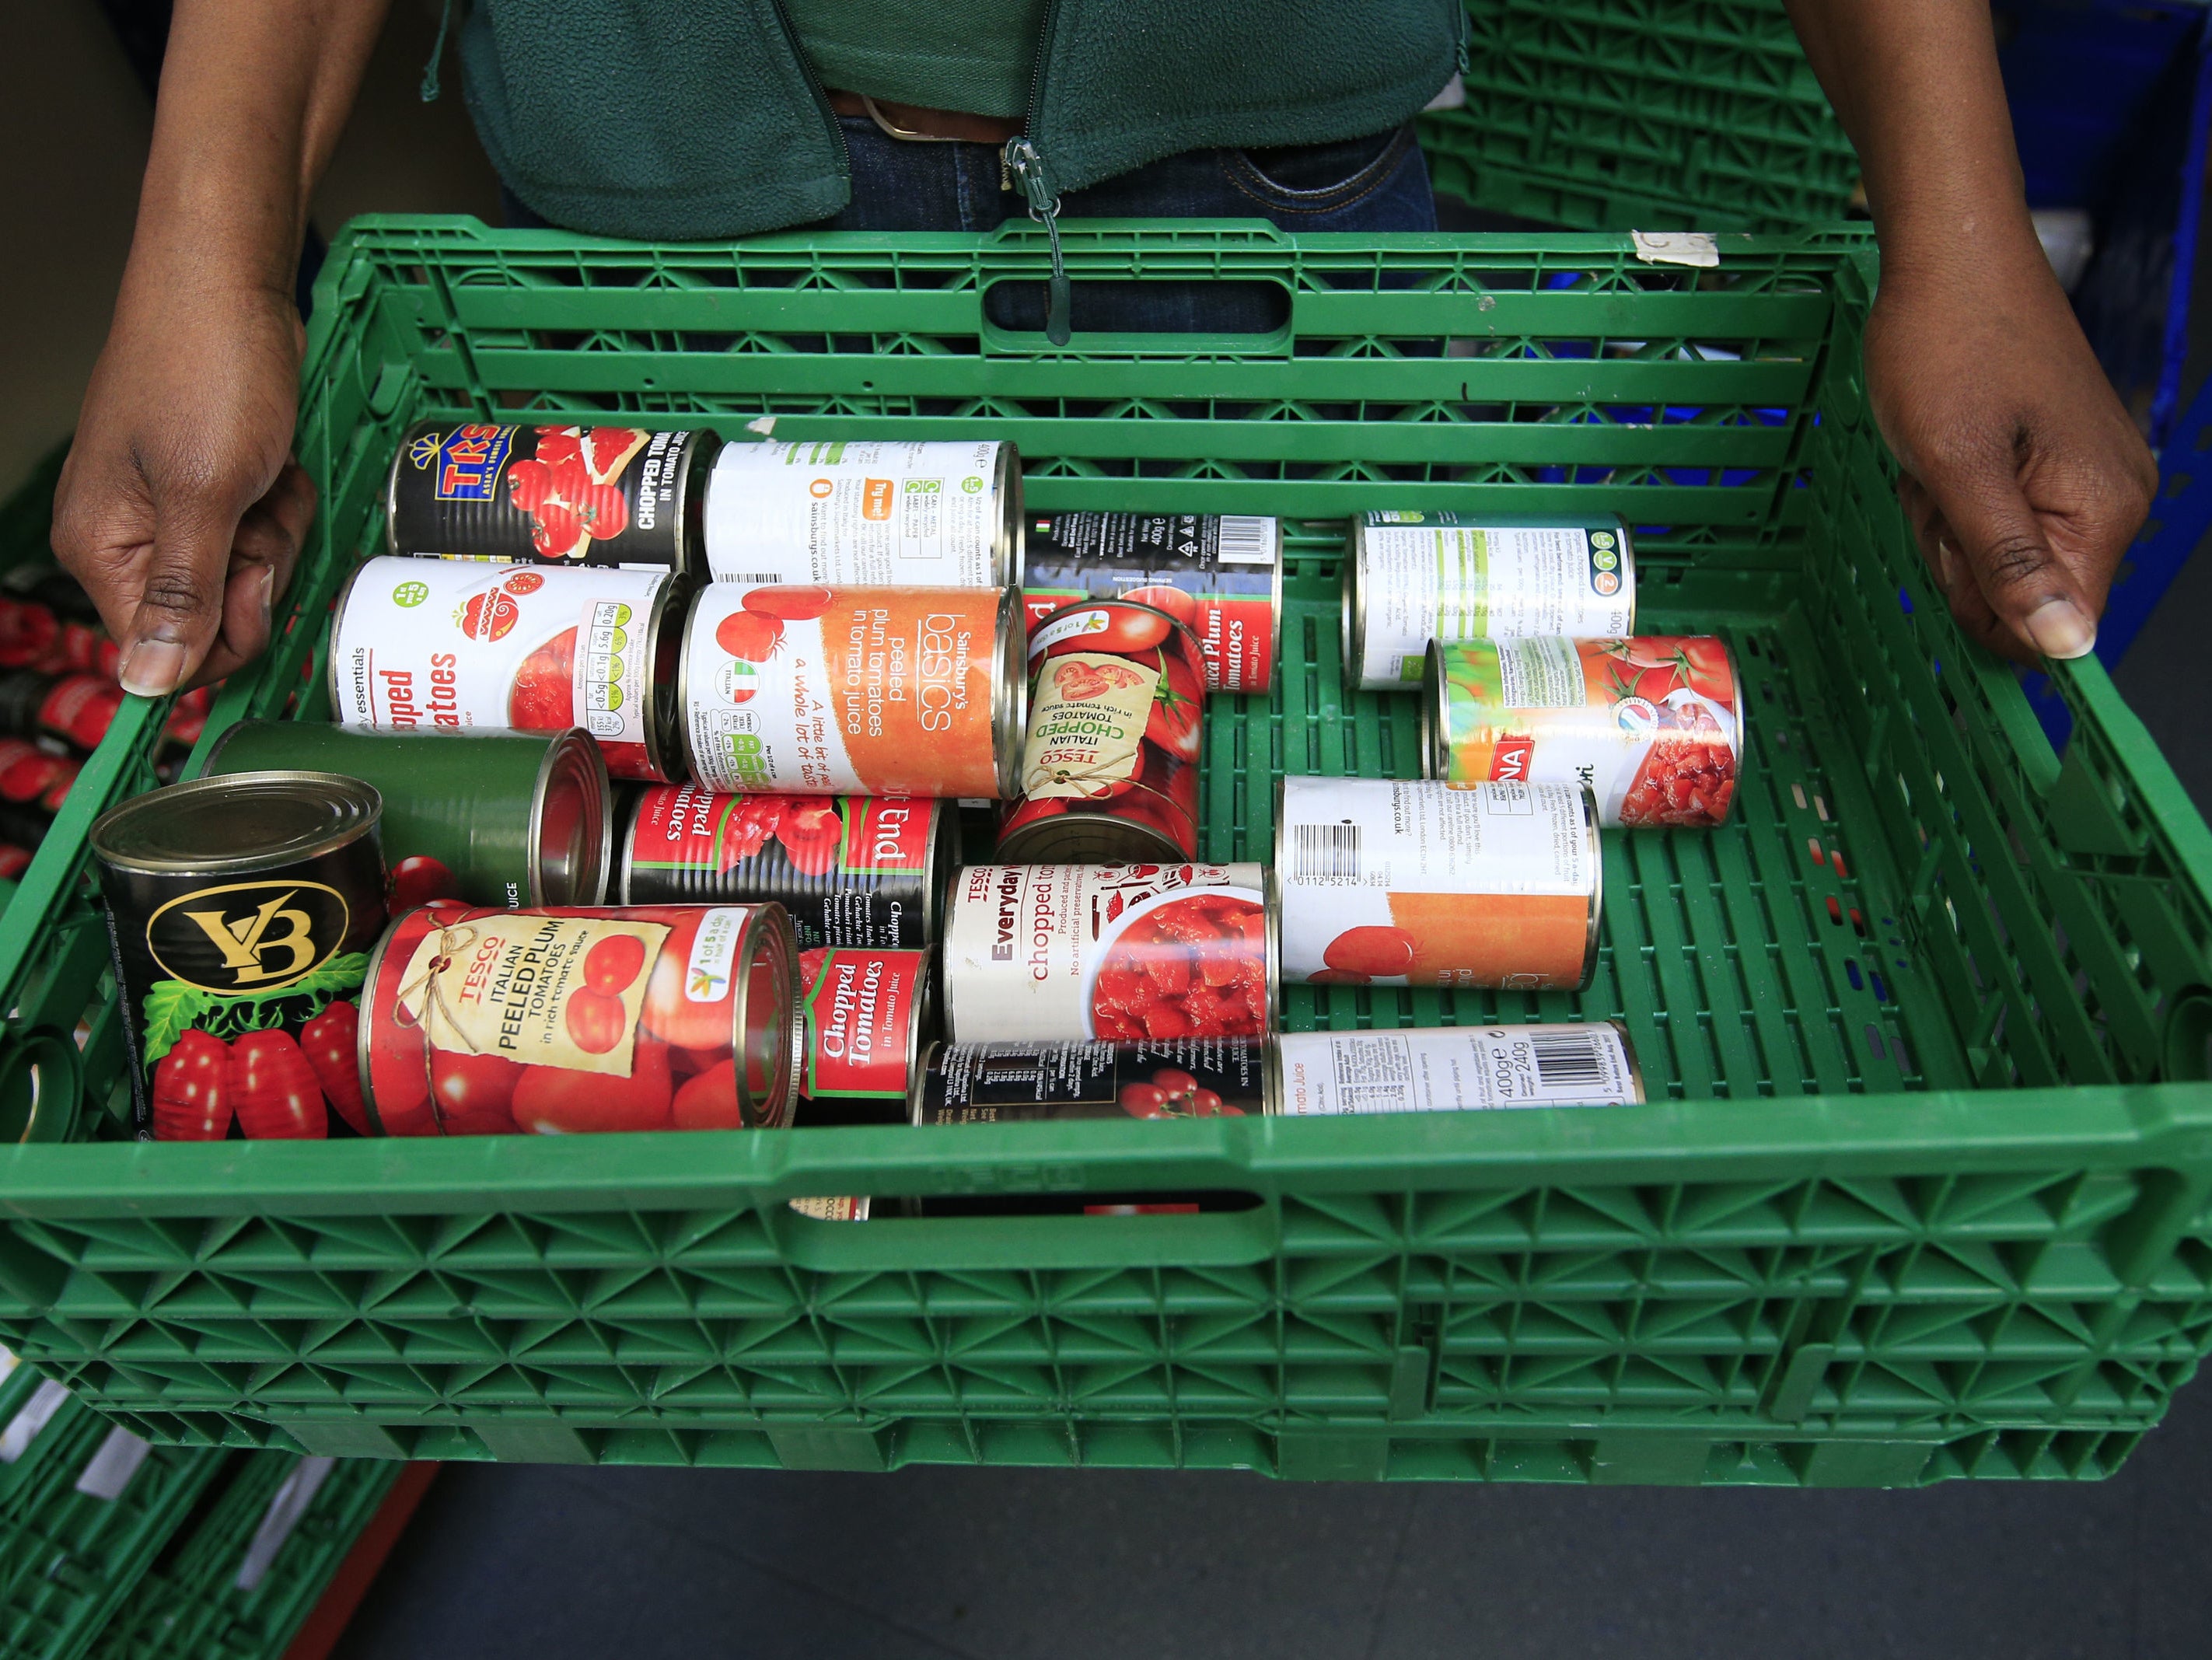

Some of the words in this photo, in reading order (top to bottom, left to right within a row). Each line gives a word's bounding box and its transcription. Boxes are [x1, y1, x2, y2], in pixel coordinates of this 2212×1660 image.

[442, 425, 501, 495] TRS
[973, 444, 991, 458] 400g
[661, 446, 680, 486] TOMATO
[638, 459, 662, 530] CHOPPED
[659, 488, 672, 501] IN
[834, 479, 844, 510] Sainsbury's
[843, 479, 852, 504] Produced
[872, 482, 887, 496] Try
[852, 491, 861, 518] statutory
[873, 498, 883, 517] me!
[809, 502, 821, 582] sainsburys.co.uk
[1151, 526, 1165, 545] 400g
[1574, 531, 1584, 554] Organic
[1566, 538, 1574, 561] tomato
[976, 561, 982, 570] as
[1566, 562, 1575, 579] juice
[1577, 555, 1586, 585] chopped
[602, 605, 617, 624] 0.20g
[852, 610, 871, 621] in
[598, 631, 612, 648] 5.6g
[870, 609, 891, 646] plum
[1202, 609, 1221, 657] Plum
[614, 636, 623, 645] 6%
[1249, 635, 1261, 657] Juice
[795, 659, 806, 669] a
[847, 625, 867, 686] tomato
[1223, 620, 1243, 690] Tomatoes
[352, 648, 367, 713] essentials
[596, 655, 609, 681] <0.1g
[888, 637, 907, 701] peeled
[921, 613, 966, 732] basics
[952, 631, 972, 710] Sainsbury's
[1249, 656, 1258, 680] Tomato
[596, 684, 608, 709] <0.5g
[795, 675, 809, 718] whole
[812, 700, 824, 711] A
[867, 652, 886, 736] tomatoes
[843, 690, 865, 735] juice
[1042, 703, 1064, 713] sauce
[1052, 711, 1113, 723] TOMATOES
[1104, 705, 1122, 715] rich
[795, 723, 810, 743] lot
[812, 716, 826, 743] little
[1036, 722, 1125, 740] CHOPPED
[1050, 736, 1099, 746] ITALIAN
[797, 746, 812, 760] of
[815, 746, 829, 760] bit
[1040, 753, 1096, 765] TESCO
[817, 762, 830, 772] of
[652, 805, 665, 826] Juice
[1566, 800, 1575, 817] counts
[1404, 816, 1413, 836] more?
[1471, 814, 1480, 829] you'll
[874, 808, 910, 862] End
[1561, 833, 1571, 858] portions
[1569, 840, 1578, 856] your
[967, 867, 987, 903] TESCO
[1061, 882, 1070, 894] and
[1297, 876, 1324, 886] 0112
[1330, 876, 1357, 887] 5214
[506, 882, 519, 909] UICE
[844, 888, 852, 925] Pomodori
[823, 897, 832, 929] Gehakte
[854, 896, 863, 931] Gehackte
[865, 893, 873, 924] Tomates
[991, 871, 1022, 961] Everyday
[1057, 895, 1068, 935] Produced
[568, 930, 589, 956] sauce
[702, 945, 714, 956] of
[710, 914, 727, 927] day
[1028, 883, 1055, 981] chopped
[1070, 917, 1080, 959] artificial
[458, 936, 499, 1004] TESCO
[490, 945, 524, 1003] ITALIAN
[528, 943, 566, 1019] TOMATOES
[550, 959, 575, 1002] tomato
[1071, 961, 1079, 977] No
[498, 967, 536, 1050] PEELED
[523, 921, 565, 964] PLUM
[886, 972, 900, 995] Juice
[543, 1005, 558, 1029] rich
[823, 963, 857, 1058] Chopped
[848, 961, 885, 1067] Tomatoes
[882, 994, 896, 1036] Tomato
[539, 1033, 552, 1044] in
[881, 1036, 892, 1047] in
[1511, 1042, 1530, 1072] 240g
[1241, 1077, 1249, 1087] IN
[1293, 1063, 1306, 1086] Juice
[1337, 1062, 1345, 1084] Reference
[1612, 1064, 1620, 1079] Before
